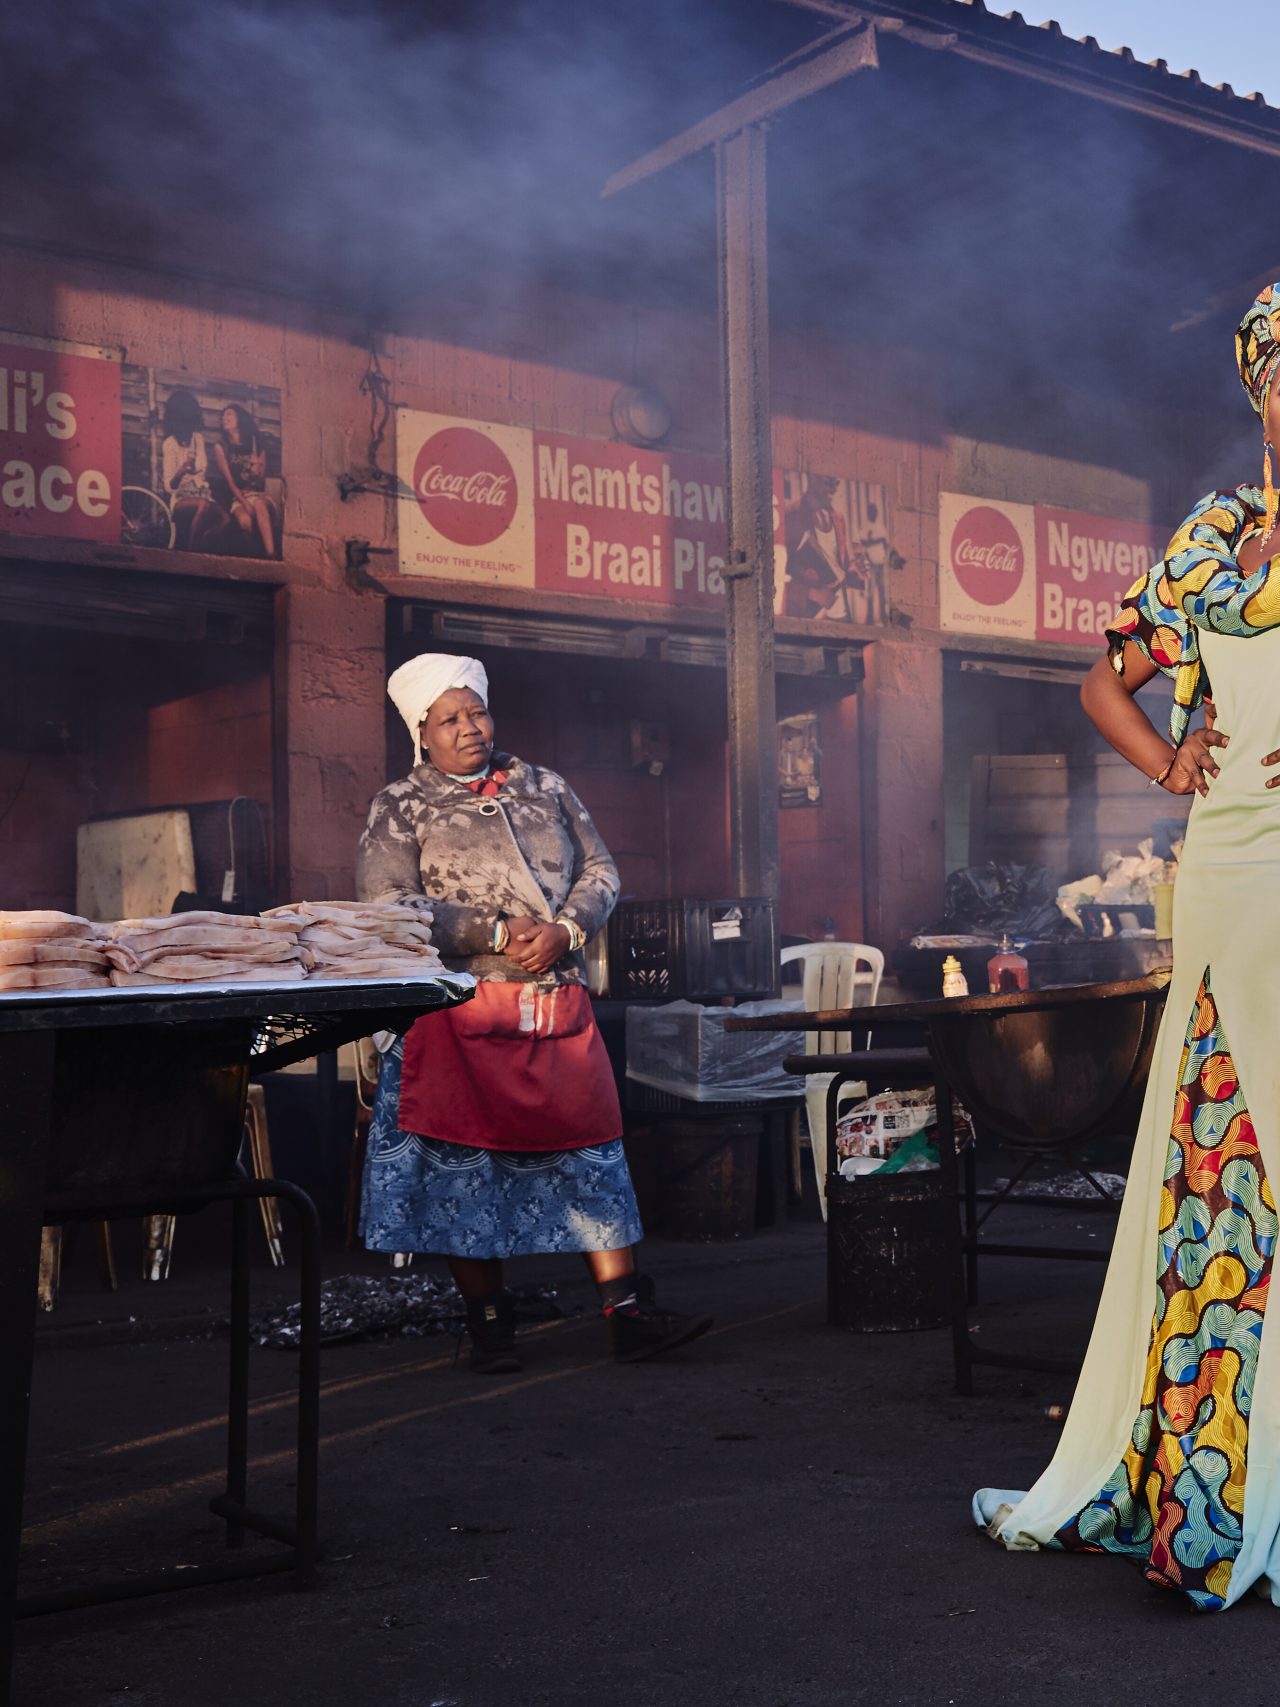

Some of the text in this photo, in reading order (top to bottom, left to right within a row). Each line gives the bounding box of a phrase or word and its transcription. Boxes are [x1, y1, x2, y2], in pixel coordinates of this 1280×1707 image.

[420, 465, 512, 507] Coca-Cola
[538, 444, 725, 524] Mamtshaw
[416, 552, 448, 565] ENJOY
[453, 557, 473, 568] THE
[566, 523, 726, 595] Braai Pla
[955, 538, 1019, 572] Coca-Cola
